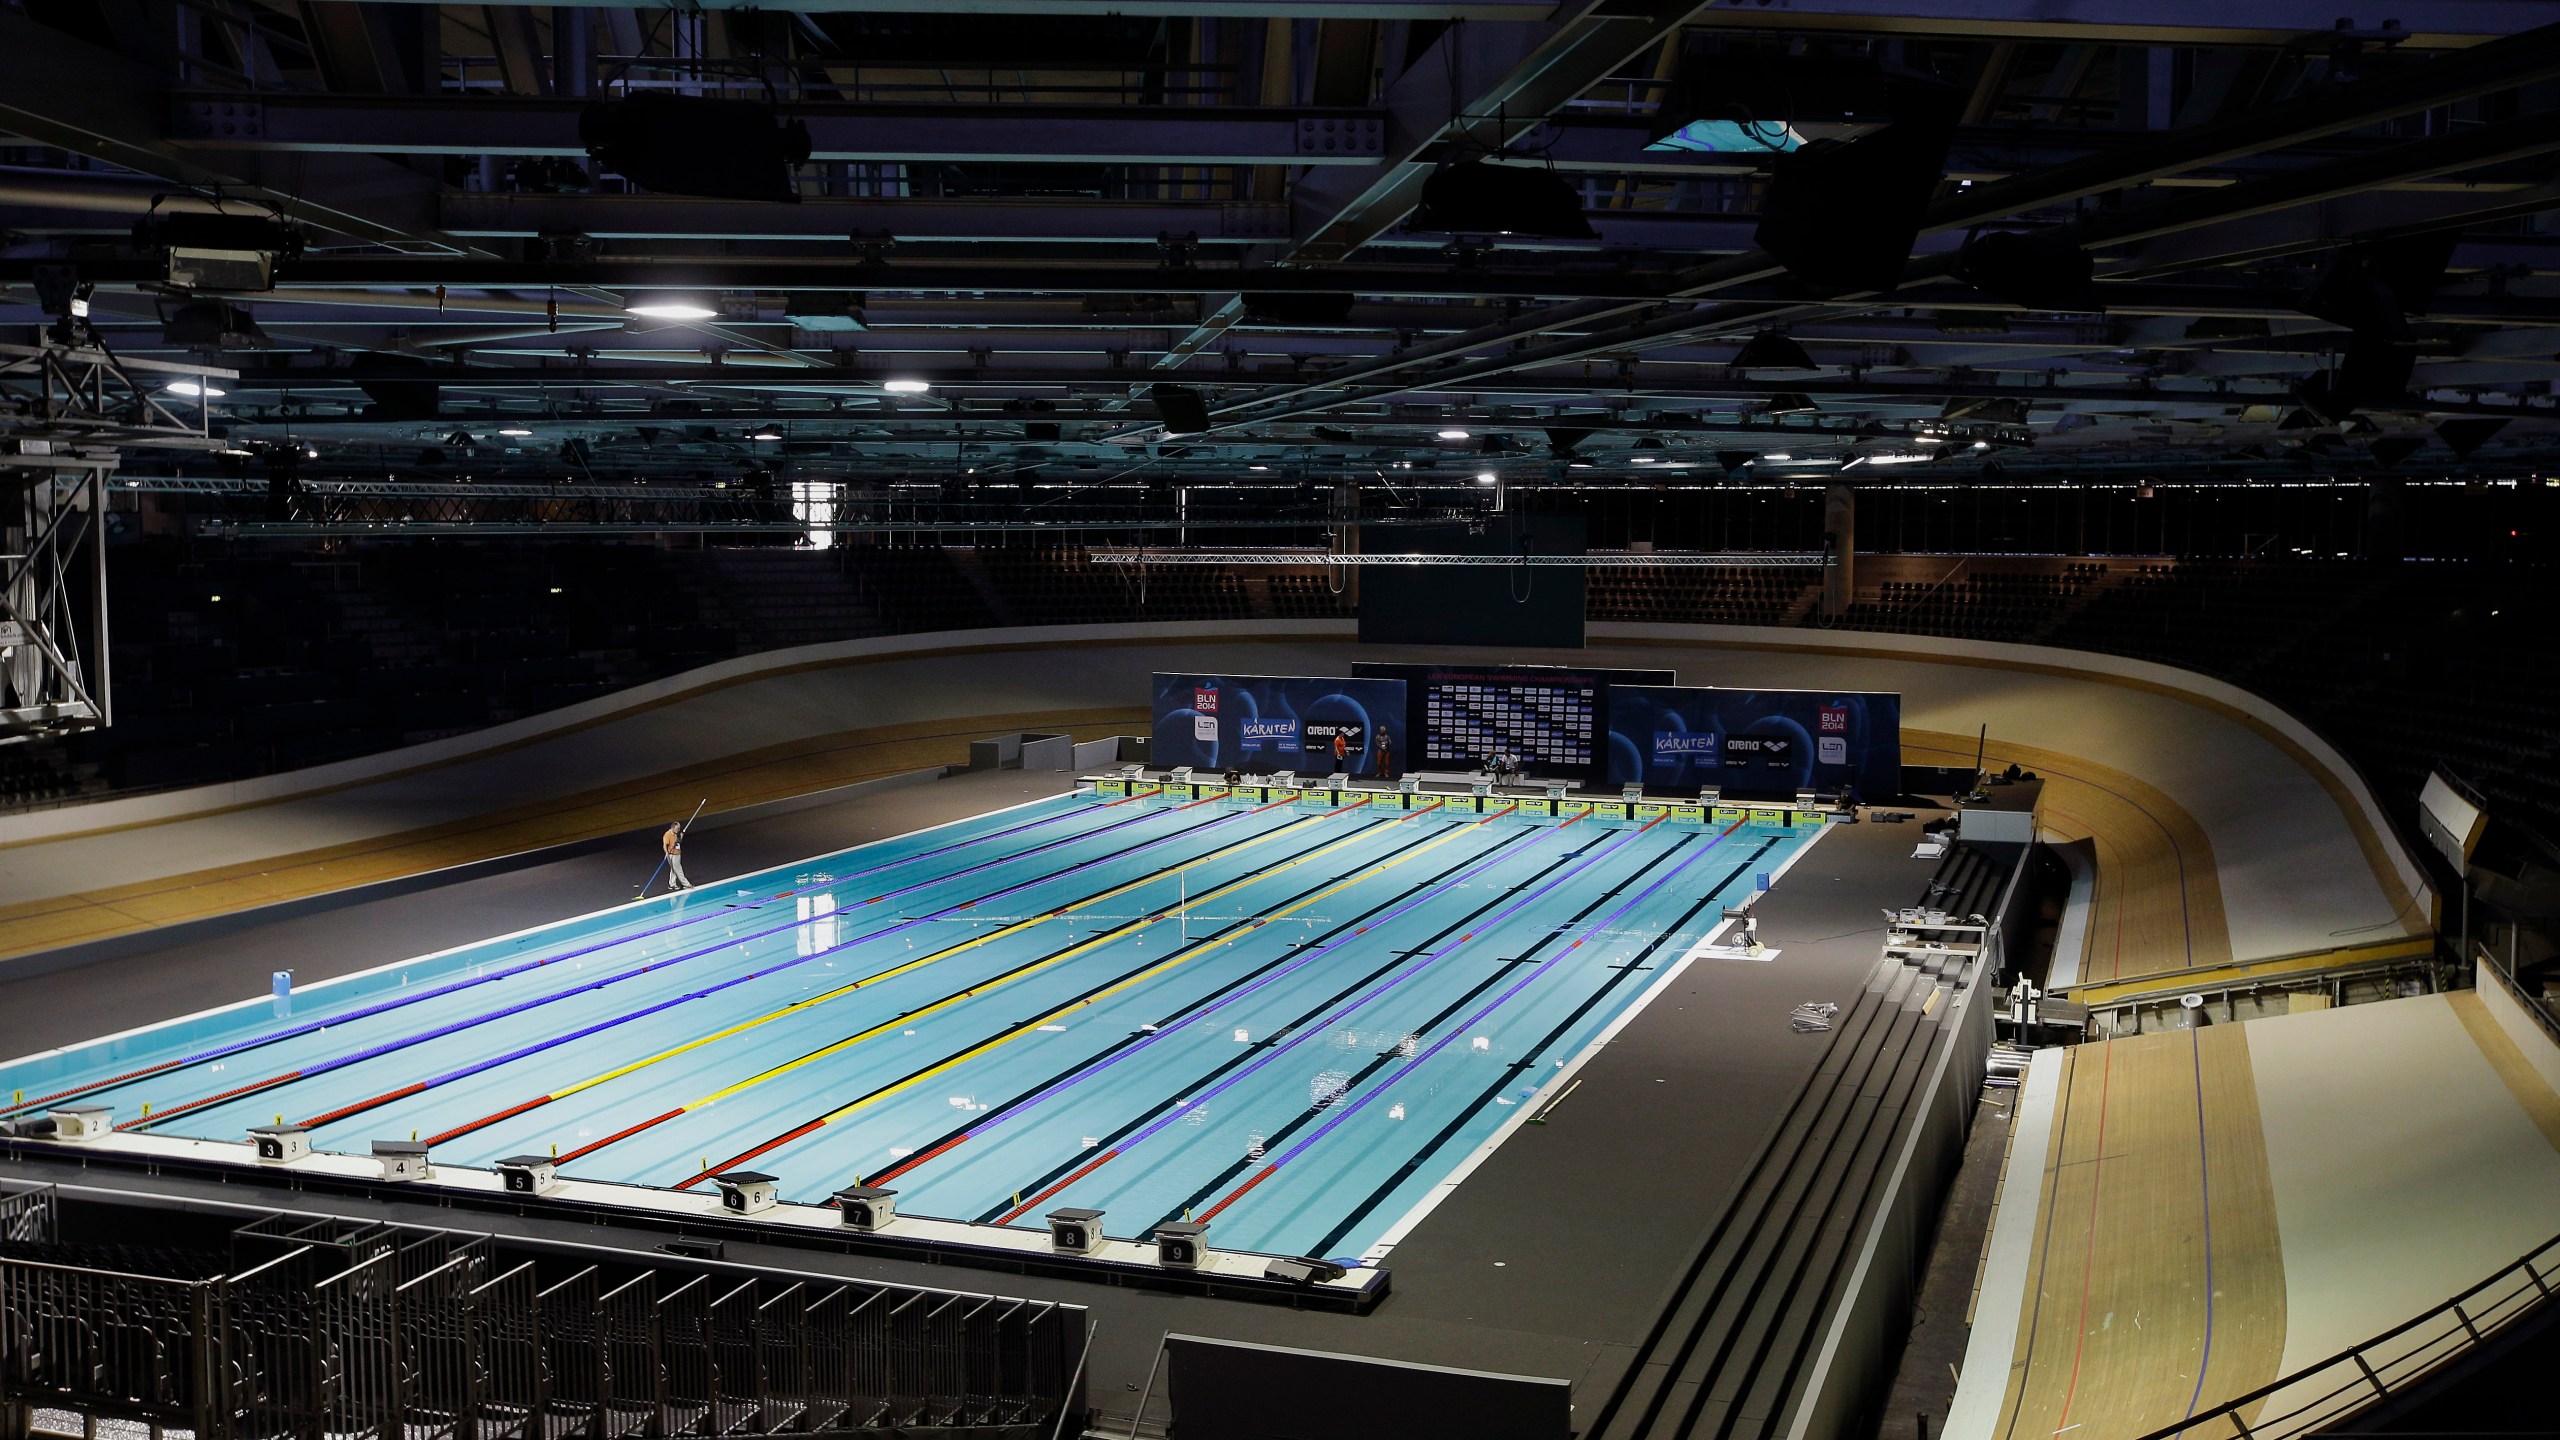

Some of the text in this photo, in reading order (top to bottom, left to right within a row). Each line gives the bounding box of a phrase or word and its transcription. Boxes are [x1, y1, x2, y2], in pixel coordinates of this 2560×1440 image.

[1486, 674, 1529, 683] SWIMMING
[1530, 675, 1595, 685] CHAMPIONSHIPS
[1196, 694, 1216, 703] BLN
[1196, 702, 1216, 710] 2014
[1822, 713, 1845, 722] BLN
[1307, 725, 1336, 736] arena
[1821, 722, 1844, 730] 2014
[1727, 740, 1760, 751] arena
[92, 1120, 98, 1132] 2
[267, 1144, 274, 1157] 3
[291, 1141, 297, 1153] 3
[396, 1162, 405, 1174] 4
[515, 1177, 523, 1189] 5
[540, 1173, 545, 1185] 5
[730, 1194, 737, 1206] 6
[754, 1191, 761, 1204] 6
[854, 1210, 862, 1223] 7
[878, 1206, 884, 1219] 7
[1066, 1232, 1075, 1245] 8
[1173, 1247, 1182, 1260] 9
